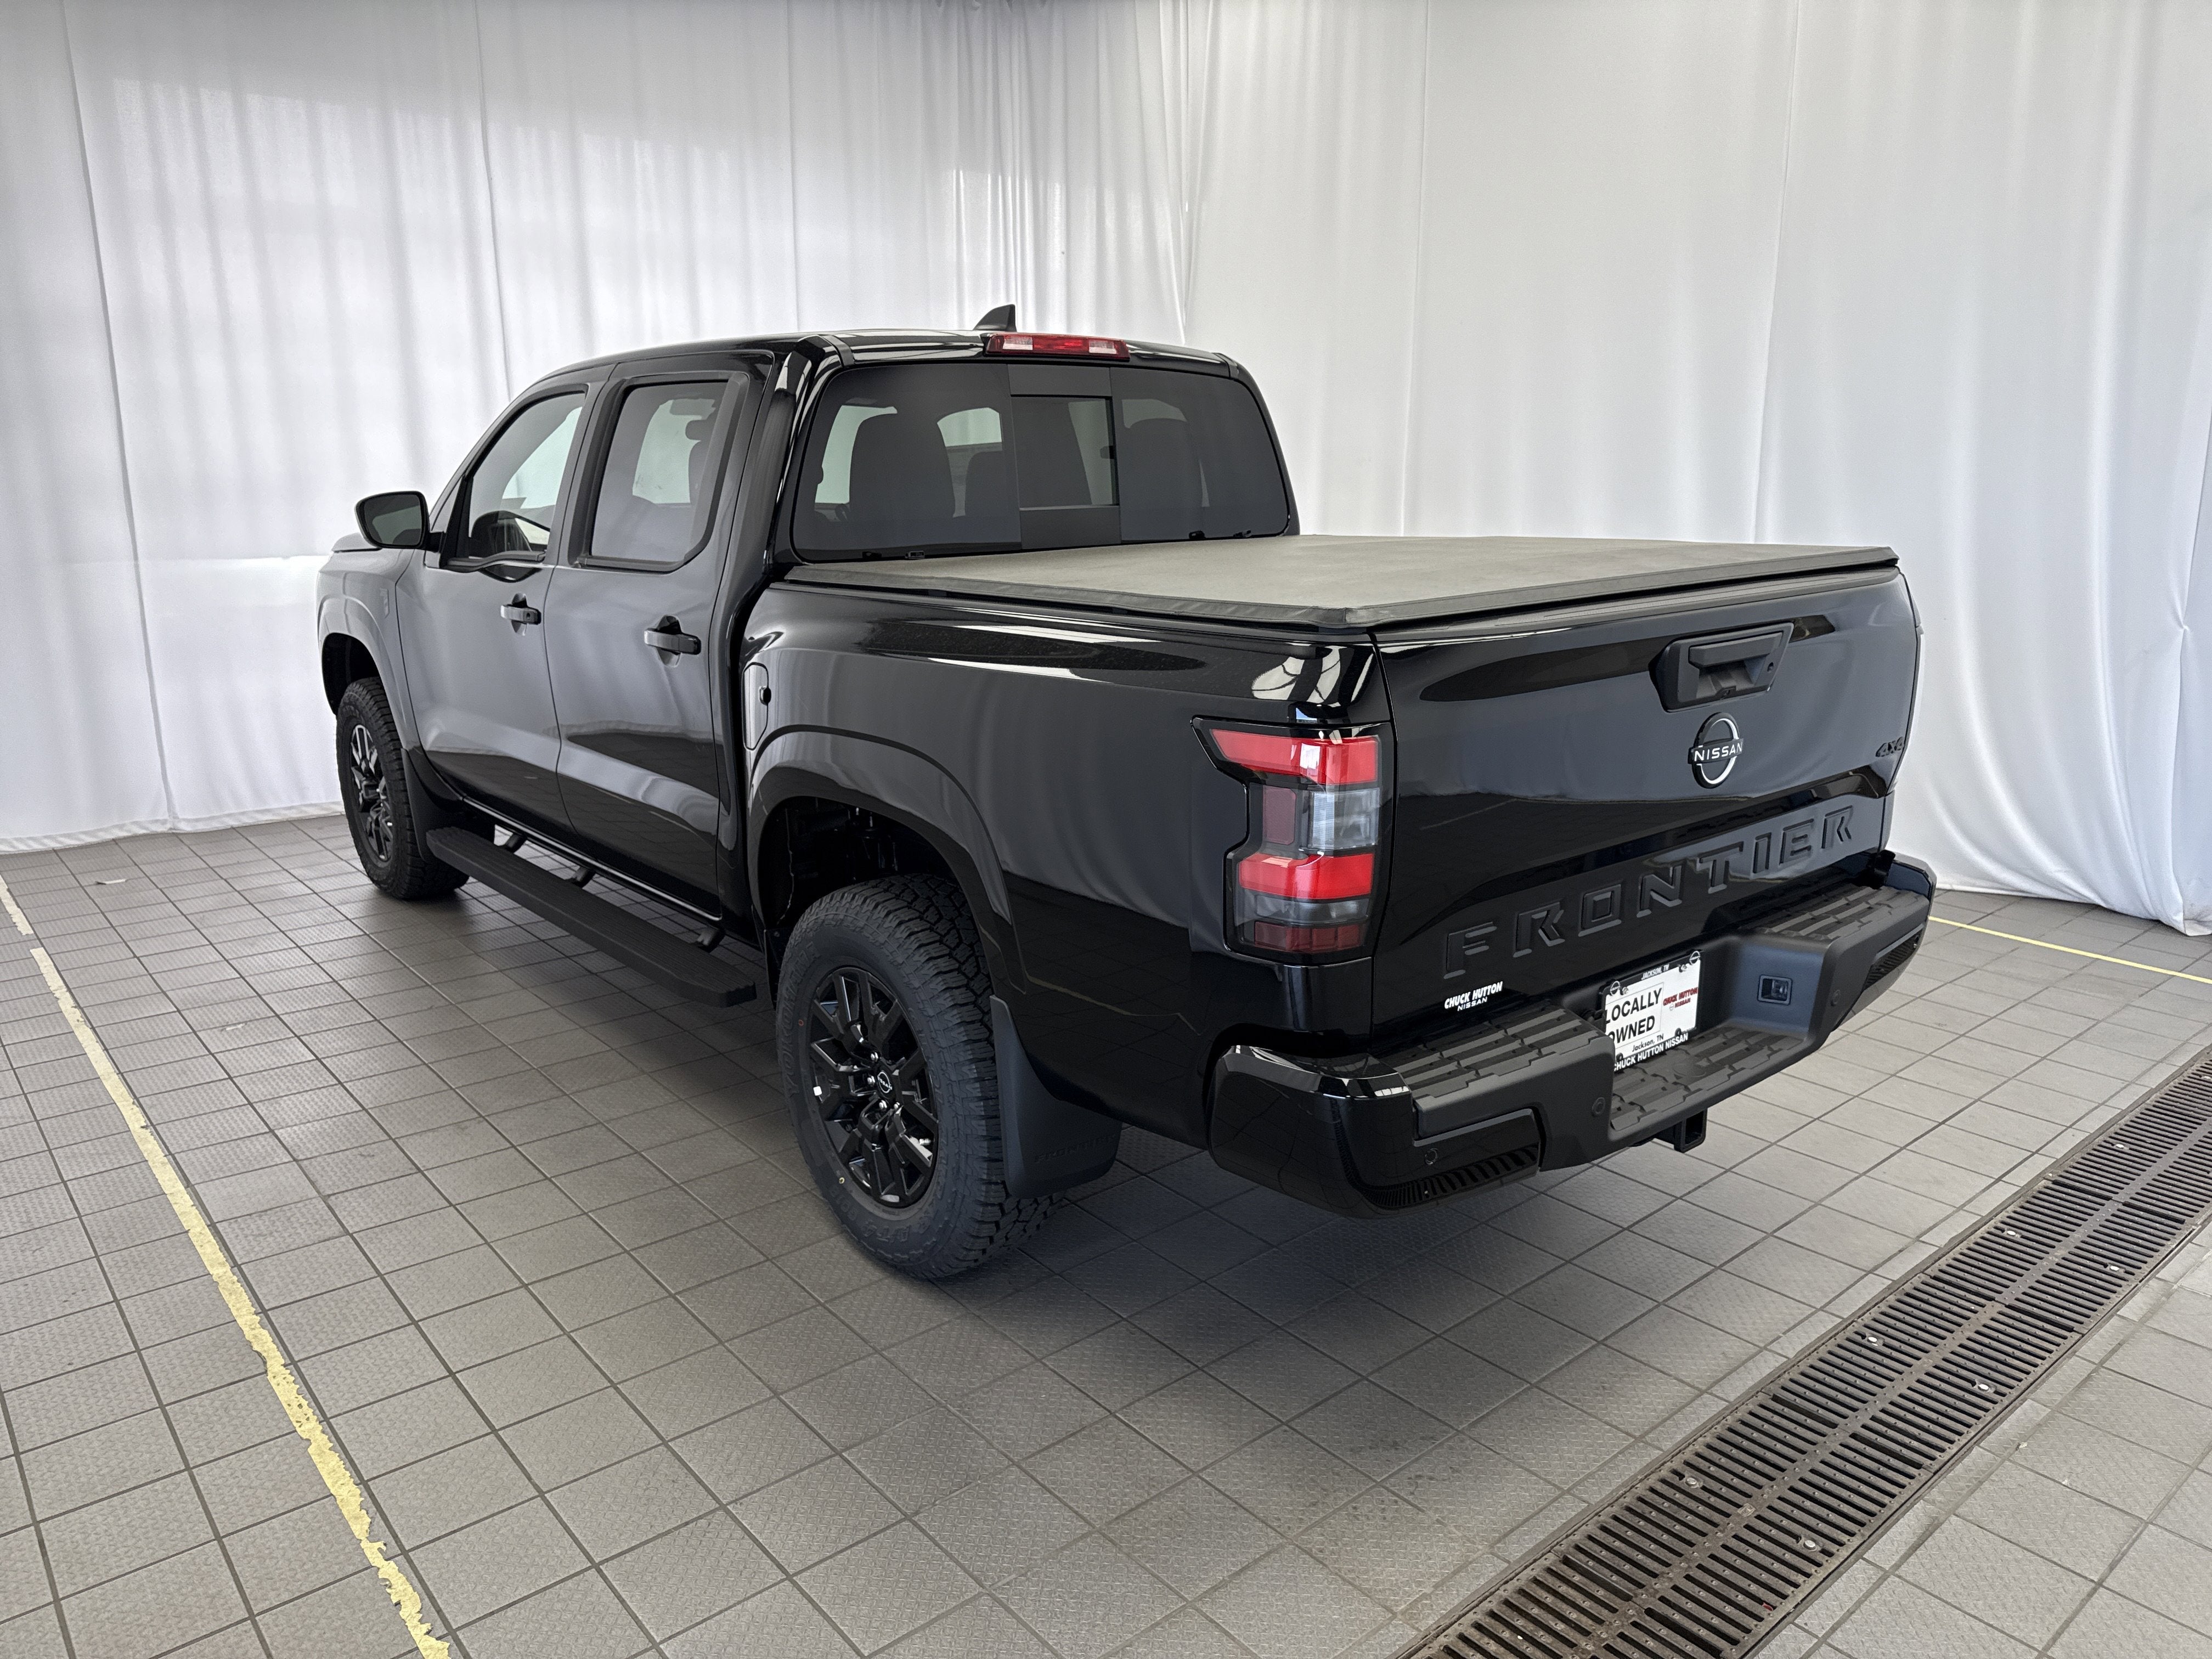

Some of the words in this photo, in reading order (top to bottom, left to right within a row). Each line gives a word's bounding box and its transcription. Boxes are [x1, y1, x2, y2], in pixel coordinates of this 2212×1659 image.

[1694, 741, 1743, 762] NISSAN
[1444, 805, 1855, 979] FRONTIER
[1444, 991, 1471, 1009] CHUCK
[1471, 980, 1503, 1000] HUTTON
[1457, 996, 1488, 1012] NISSAN
[1605, 988, 1662, 1024] LOCALLY
[1632, 1039, 1655, 1052] Jackson,
[1657, 1033, 1664, 1043] TN
[1637, 1043, 1664, 1062] HUTTON
[1665, 1032, 1688, 1050] NISSAN
